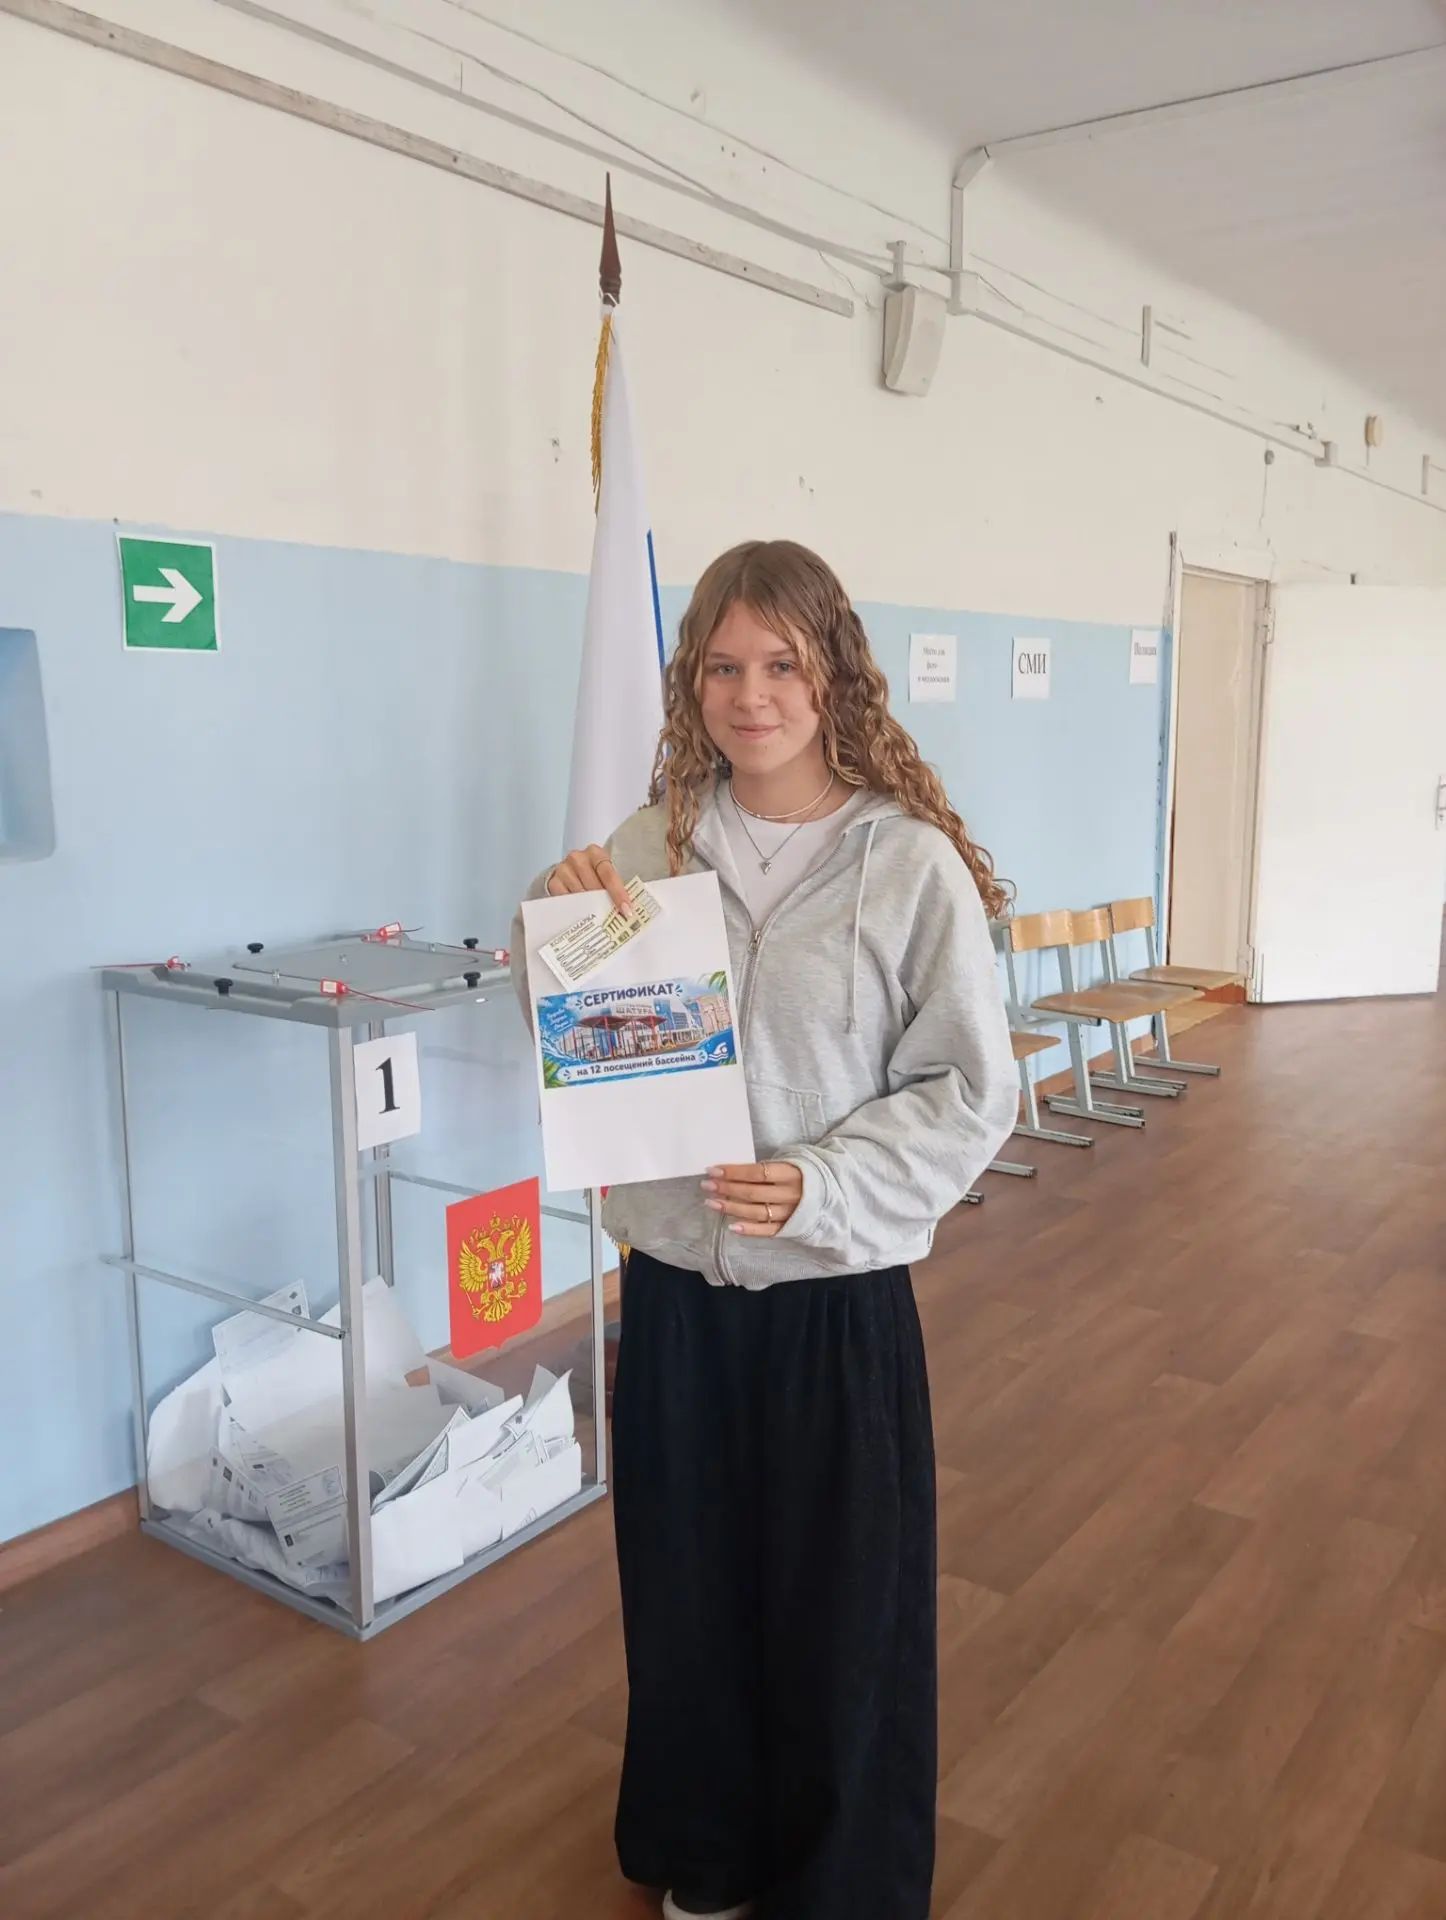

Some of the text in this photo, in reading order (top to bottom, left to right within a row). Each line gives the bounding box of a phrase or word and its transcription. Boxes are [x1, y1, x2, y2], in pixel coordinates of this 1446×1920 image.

[1018, 653, 1046, 674] СМИ
[583, 983, 674, 1007] СЕРТИФИКАТ
[576, 1053, 697, 1077] на 12 посещений бассейна
[376, 1057, 400, 1114] 1
